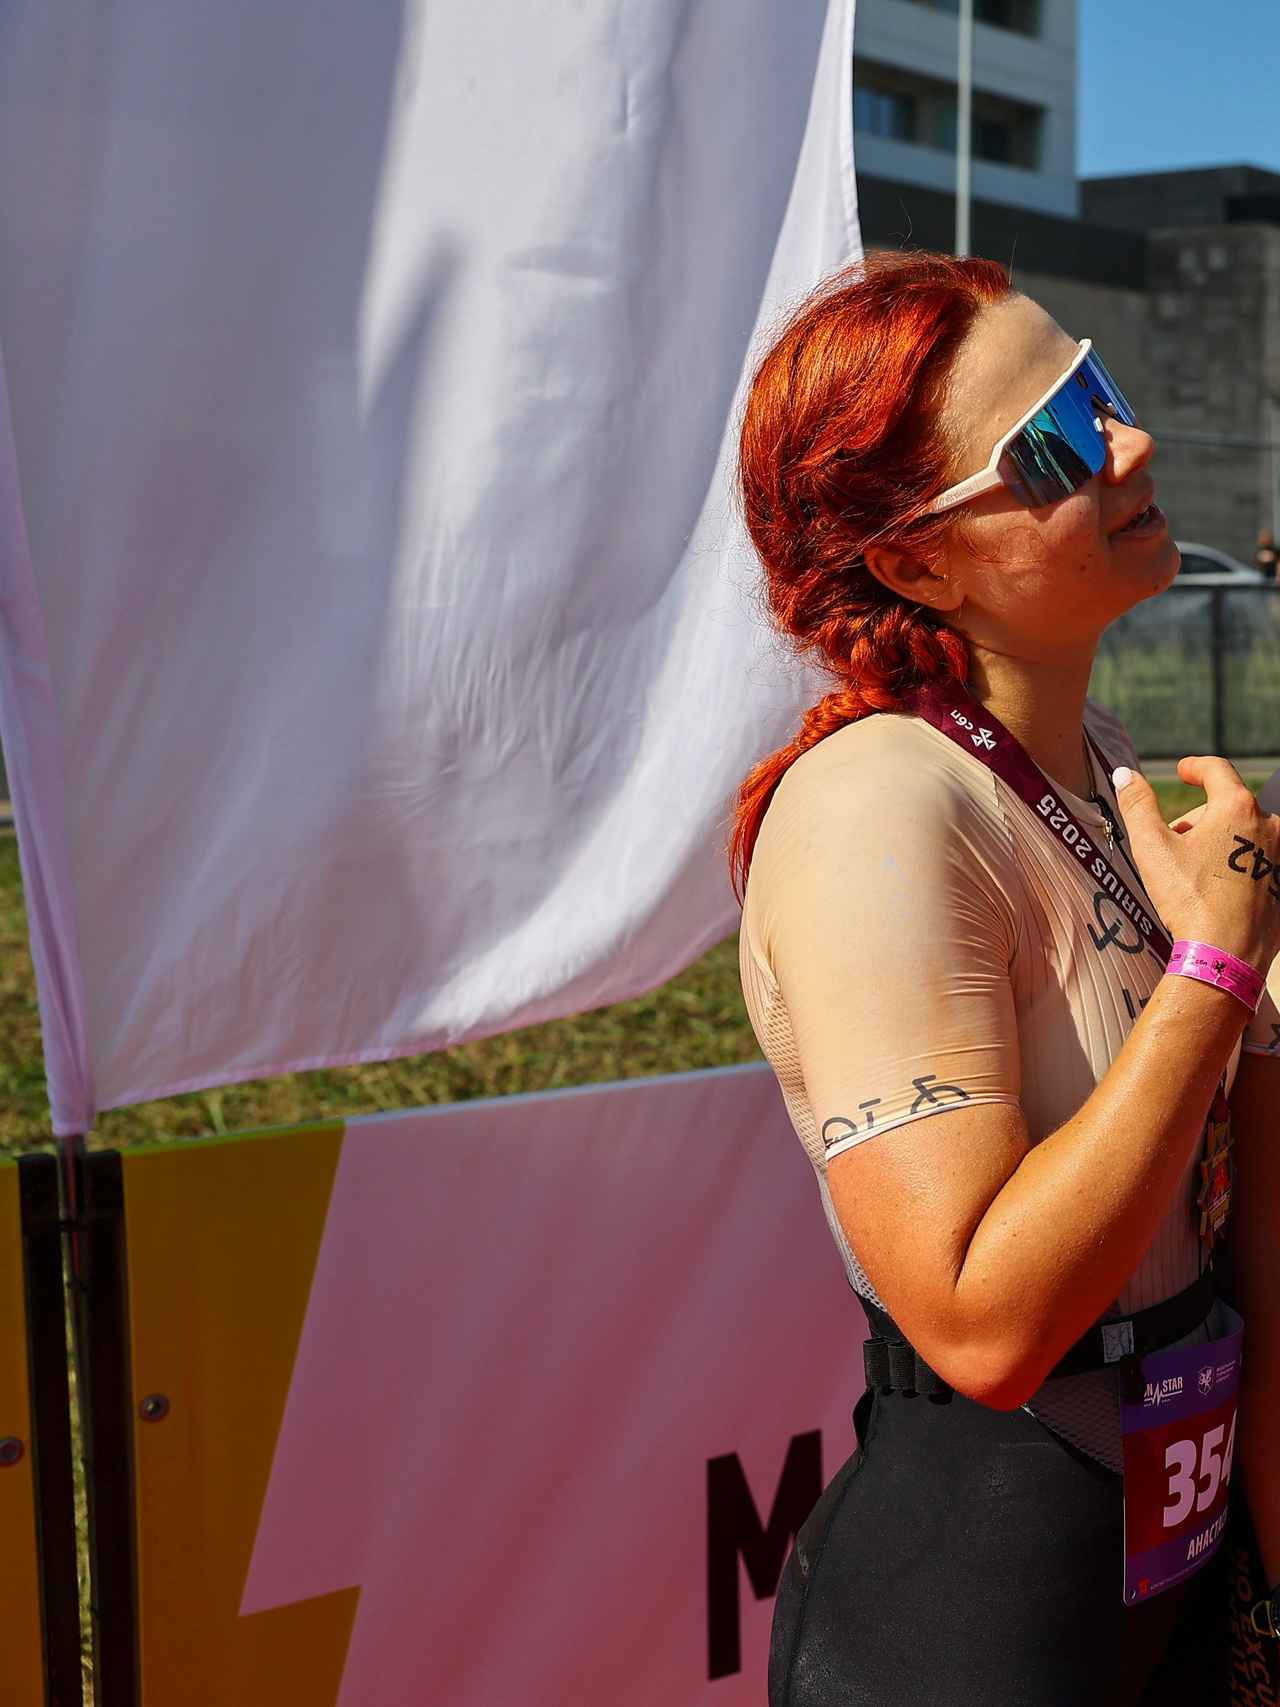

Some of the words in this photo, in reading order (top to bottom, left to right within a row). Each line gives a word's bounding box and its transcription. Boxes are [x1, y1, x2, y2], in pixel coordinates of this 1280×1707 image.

[949, 708, 975, 731] сбп
[1036, 794, 1093, 860] 2025
[1090, 857, 1154, 937] SIRIUS
[1162, 1376, 1184, 1393] STAR
[1162, 1406, 1238, 1528] 354
